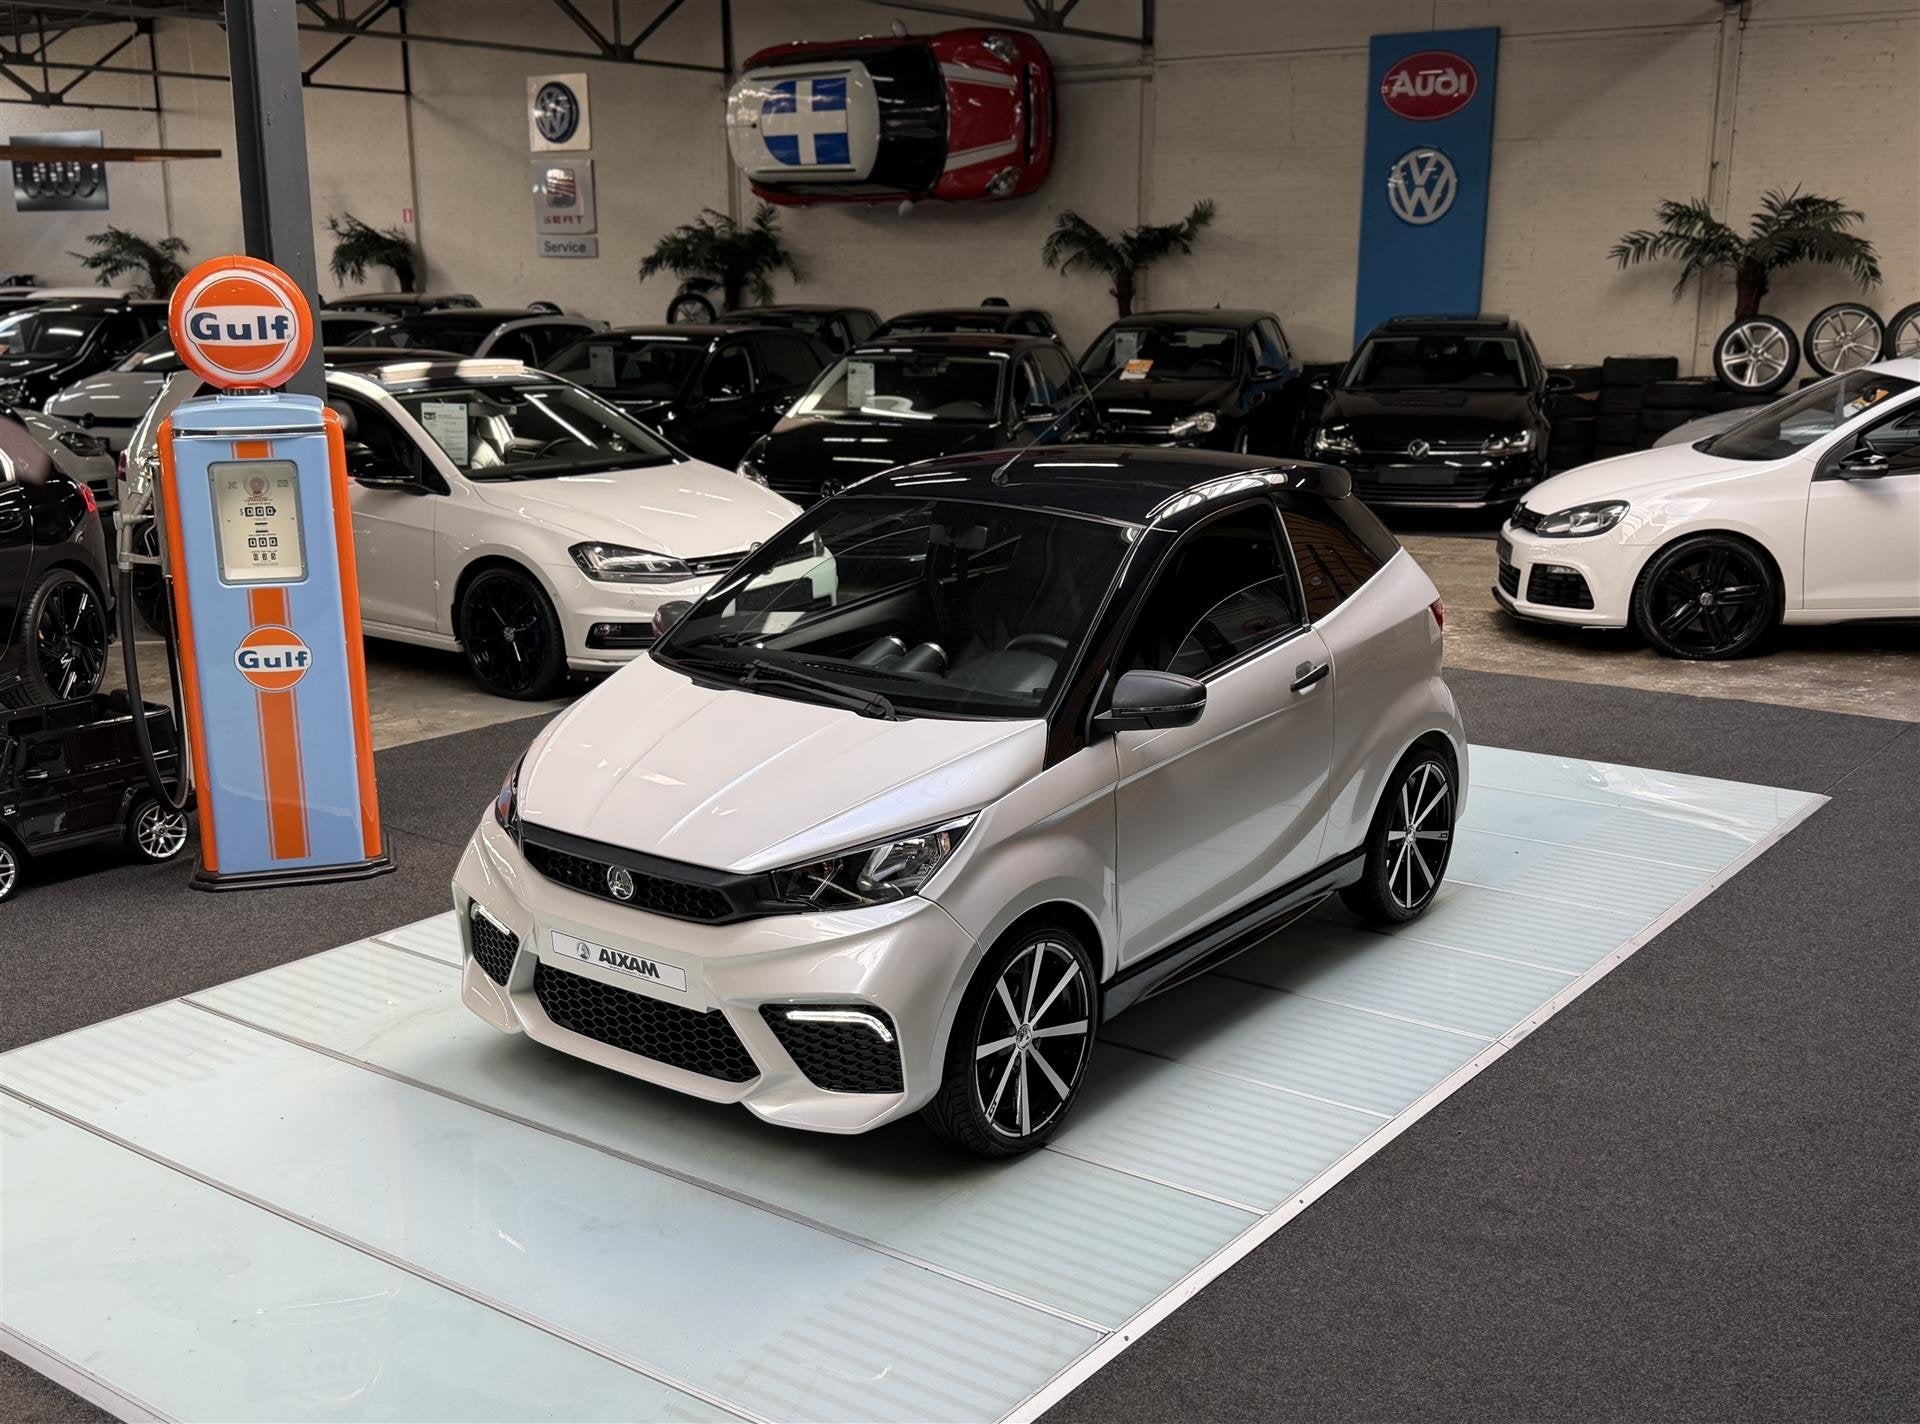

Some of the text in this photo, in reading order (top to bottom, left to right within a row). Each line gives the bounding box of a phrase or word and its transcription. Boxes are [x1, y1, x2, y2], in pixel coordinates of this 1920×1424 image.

[1389, 67, 1469, 98] Audi
[544, 240, 587, 254] Service
[190, 311, 289, 341] Gulf
[238, 650, 308, 669] Gulf
[598, 947, 661, 979] AIXAM
